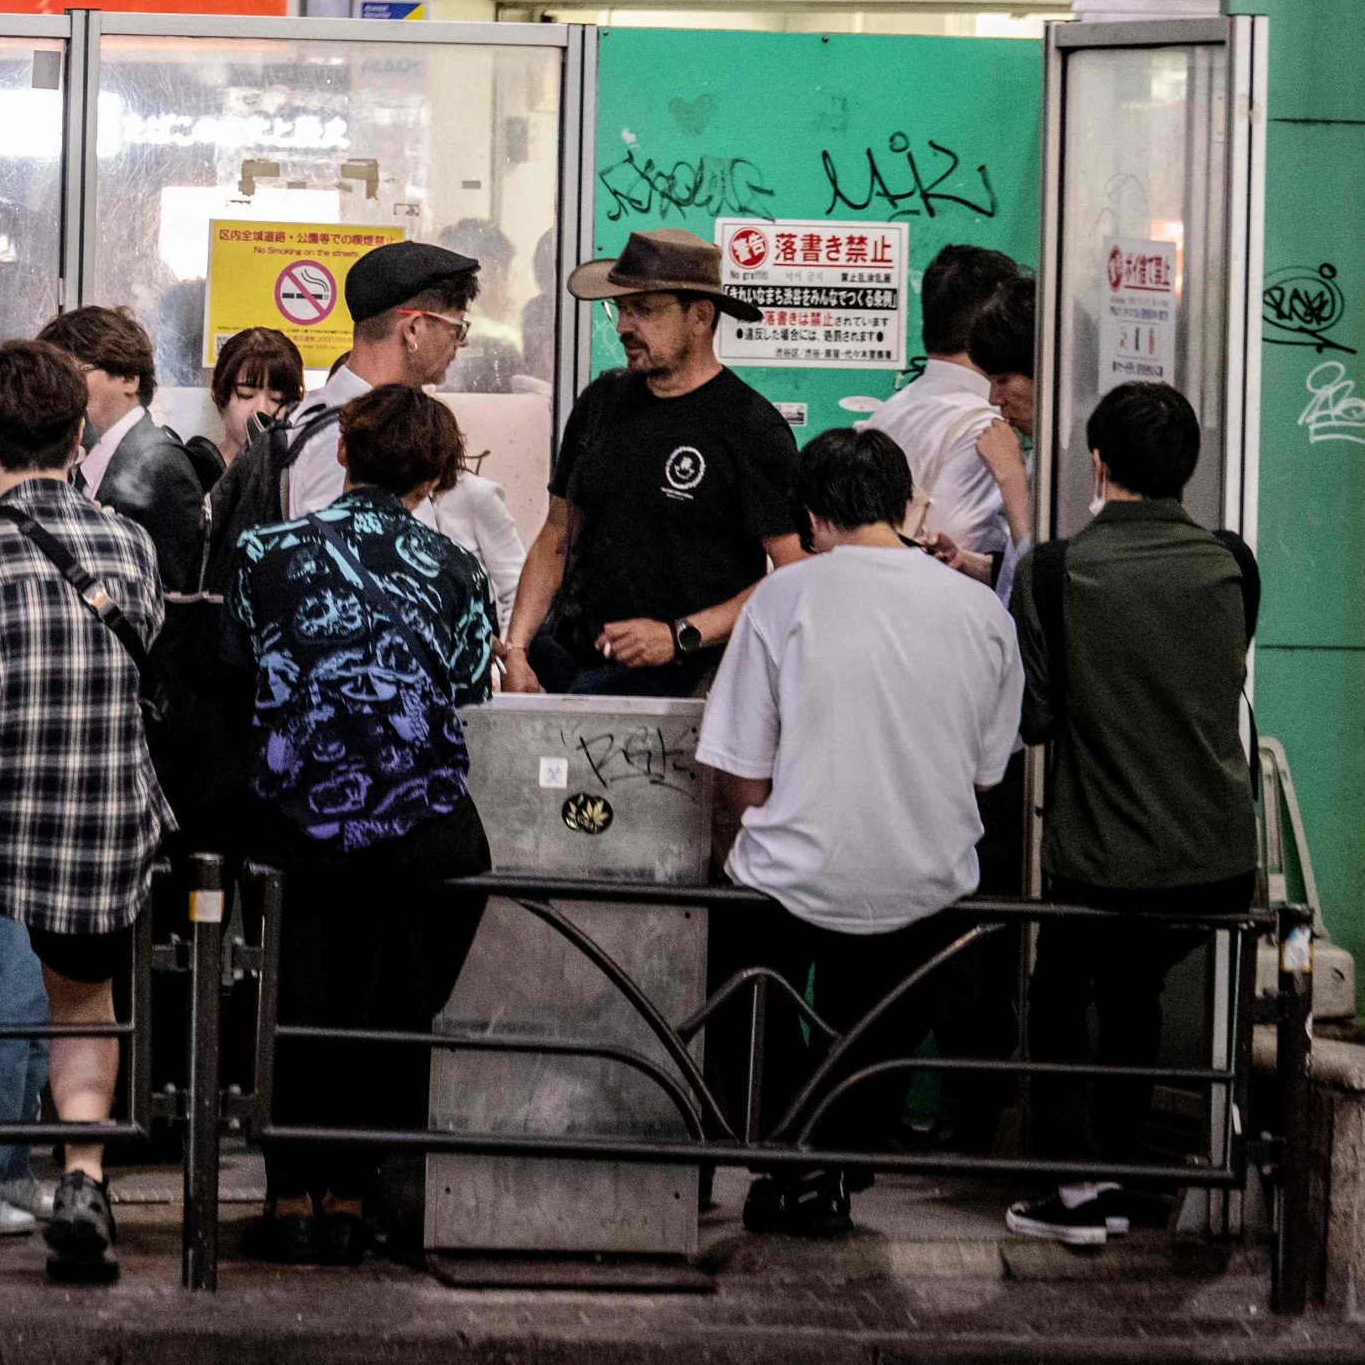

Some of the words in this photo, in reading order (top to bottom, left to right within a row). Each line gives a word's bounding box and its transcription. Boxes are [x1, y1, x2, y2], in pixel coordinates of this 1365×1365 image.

[254, 246, 265, 254] No
[774, 233, 893, 263] 落書き禁止
